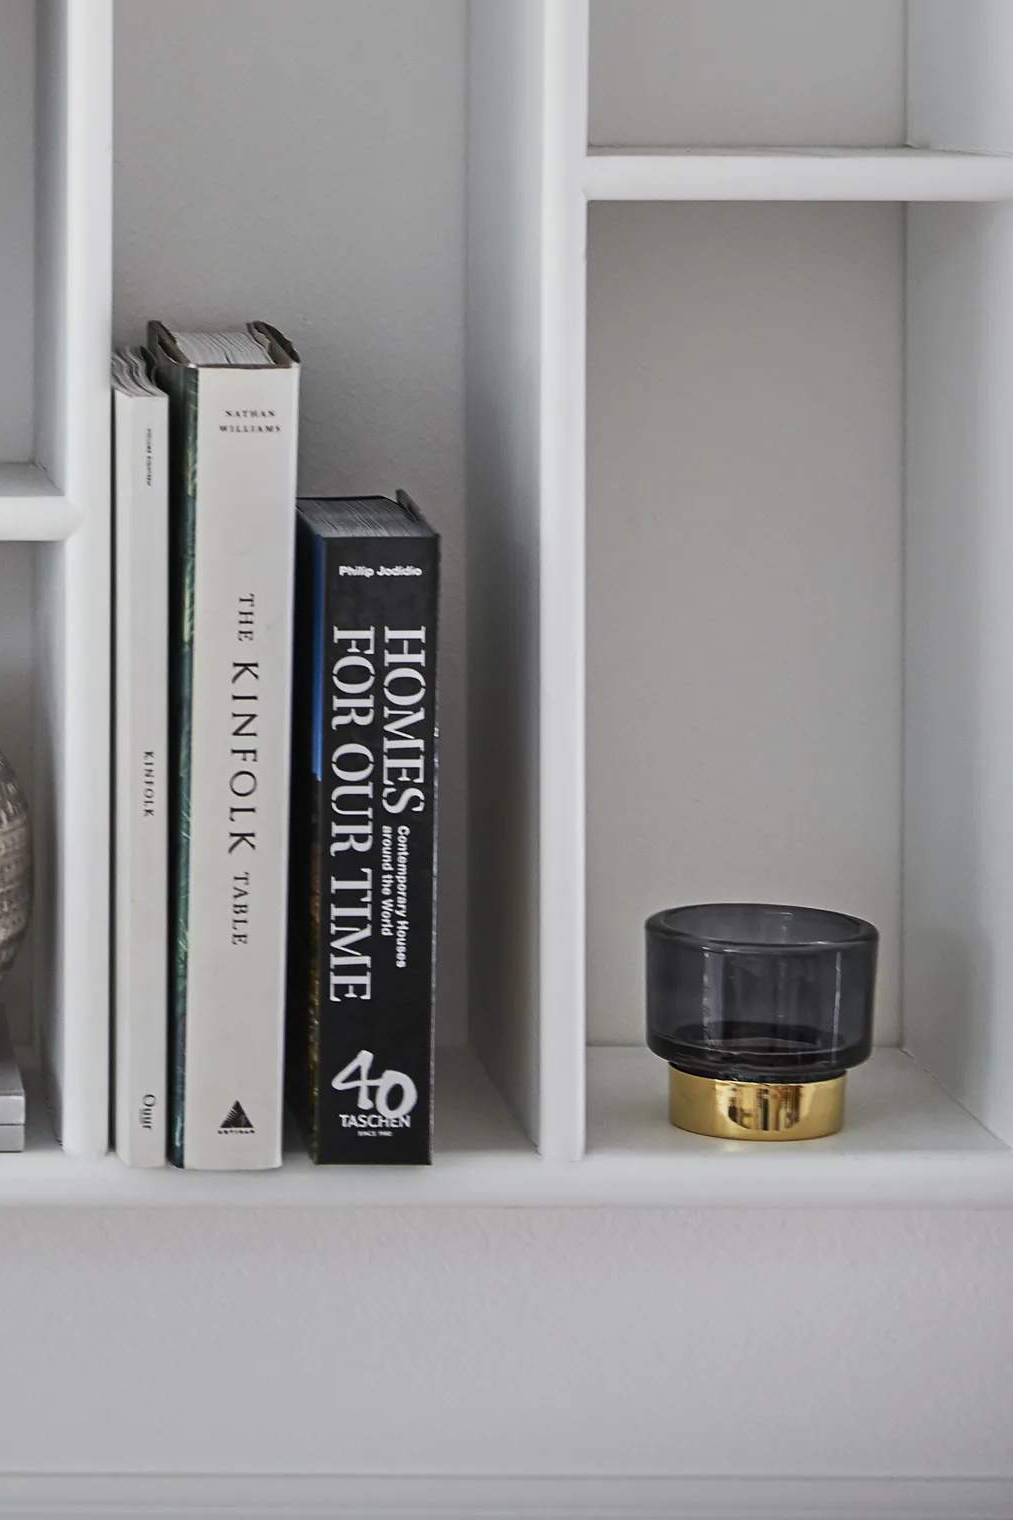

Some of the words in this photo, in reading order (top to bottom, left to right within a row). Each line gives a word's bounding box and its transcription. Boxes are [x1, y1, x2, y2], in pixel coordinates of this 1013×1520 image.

[219, 425, 281, 433] WILLIAMS
[225, 410, 275, 418] NATHAN
[338, 565, 374, 578] Philip
[376, 565, 423, 577] Jodidio
[238, 593, 255, 642] THE
[331, 625, 376, 730] FOR
[382, 625, 426, 814] HOMES
[143, 751, 155, 817] KINFOLK
[228, 661, 259, 854] KINFOLK
[330, 743, 374, 857] OUR
[381, 825, 394, 871] around
[394, 825, 411, 918] Contemporary
[232, 871, 250, 946] TABLE
[381, 874, 394, 896] the
[329, 867, 373, 1002] TIME
[381, 898, 394, 936] World
[395, 920, 410, 968] Houses
[331, 1049, 418, 1119] 40
[338, 1113, 411, 1128] TASCHEN
